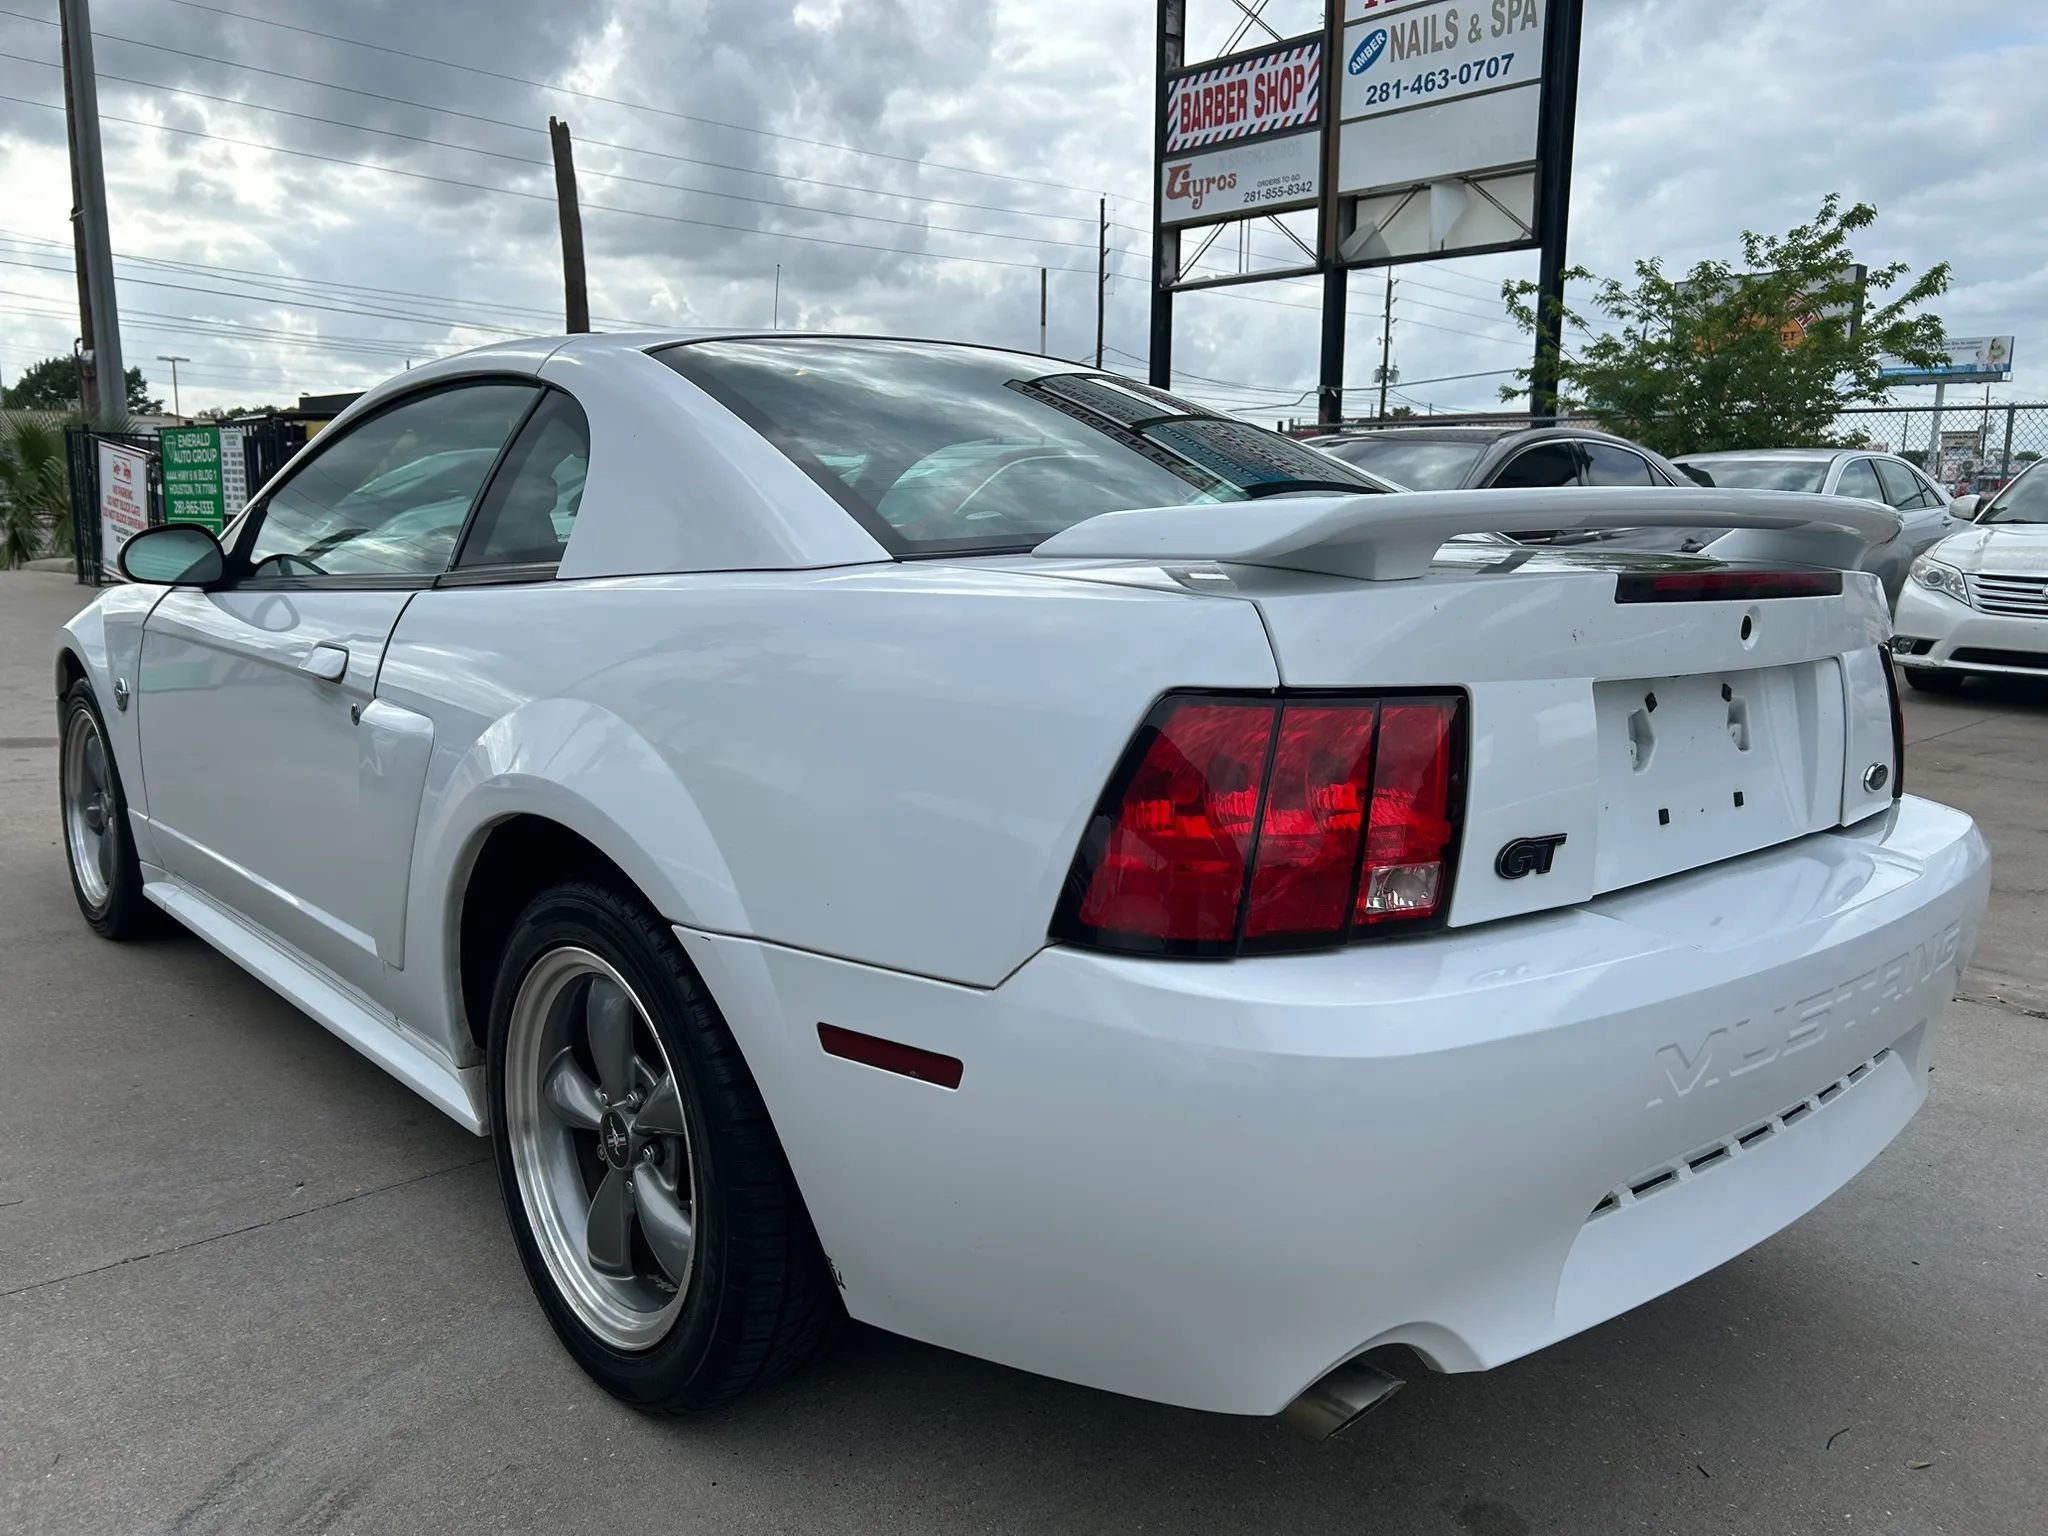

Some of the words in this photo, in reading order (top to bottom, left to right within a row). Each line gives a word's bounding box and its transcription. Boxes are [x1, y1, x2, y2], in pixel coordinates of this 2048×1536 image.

[1350, 31, 1386, 74] AMBER
[1389, 8, 1459, 63] NAILS
[1467, 13, 1482, 44] &
[1490, 0, 1538, 38] SPA
[1180, 78, 1248, 135] BARBER
[1254, 64, 1305, 119] SHOP
[1365, 52, 1515, 106] 281-463-0707
[1166, 163, 1237, 210] Gyros
[1243, 181, 1313, 203] 281-855-8342
[1257, 177, 1281, 188] ORDERS
[1282, 175, 1290, 184] TO
[1291, 173, 1301, 182] GO
[173, 449, 192, 463] AUTO
[192, 448, 217, 463] GROUP
[177, 432, 210, 448] EMERALD
[1494, 832, 1568, 880] GT
[1645, 918, 1963, 1109] MUSTANG
